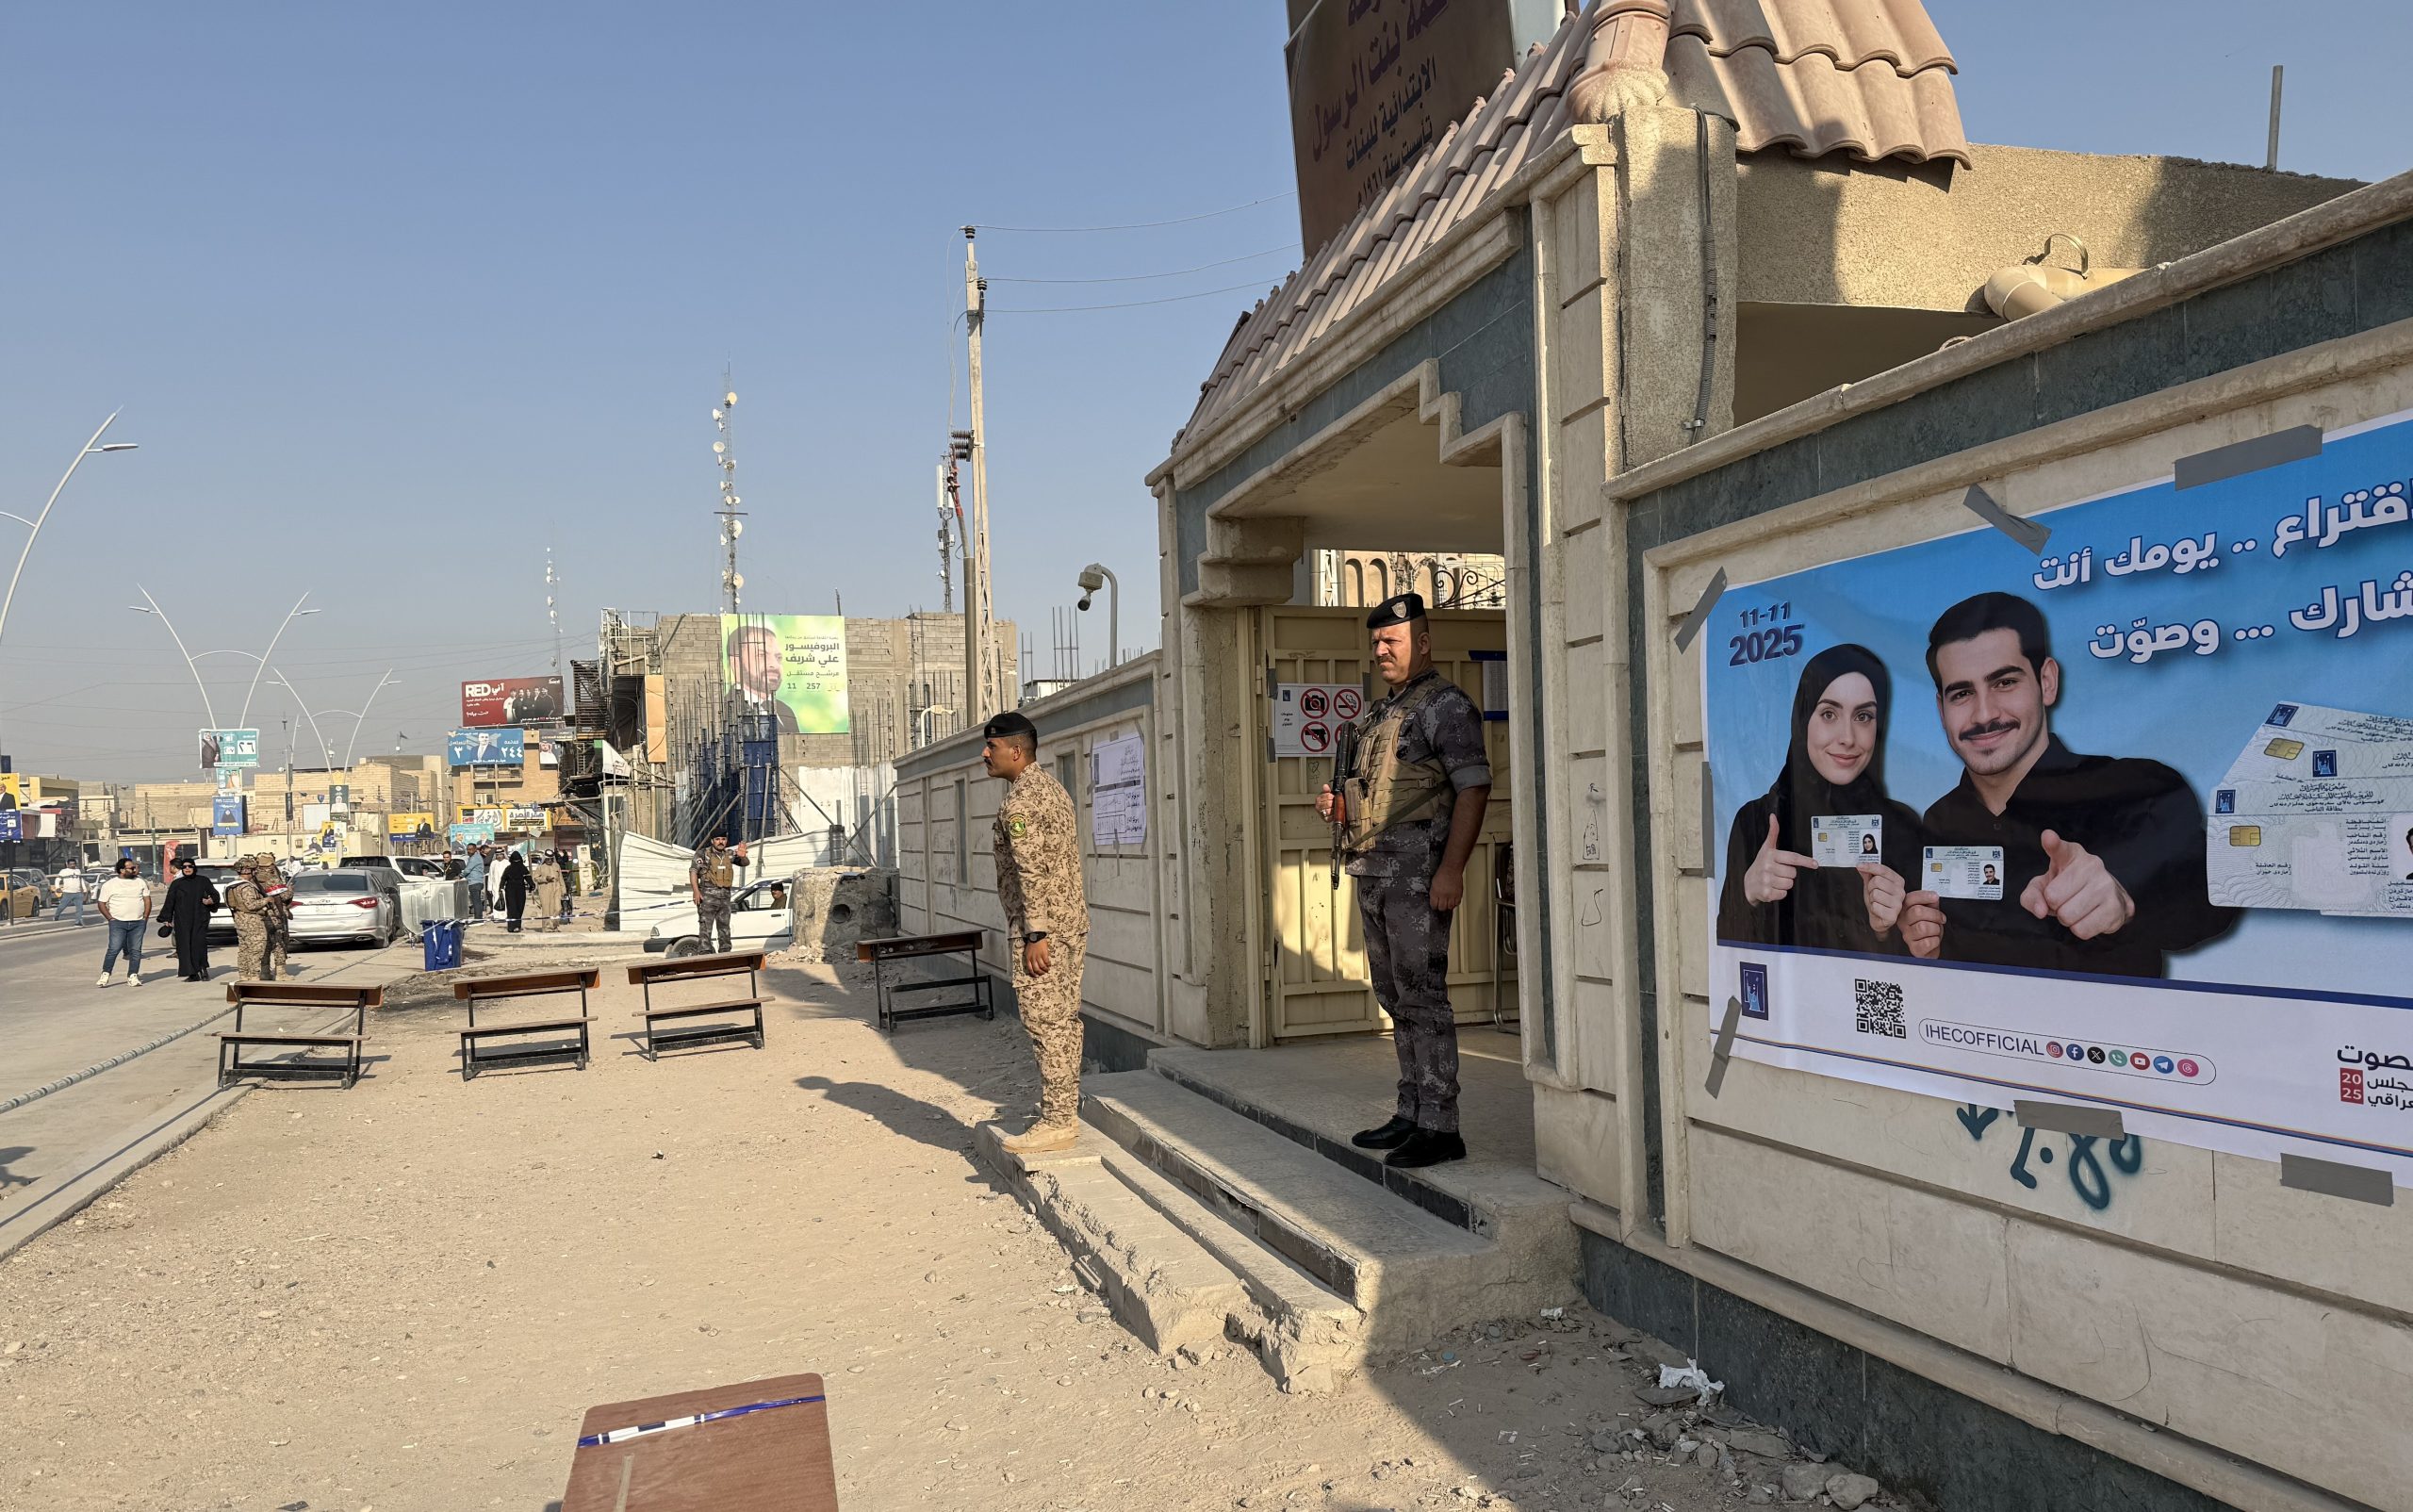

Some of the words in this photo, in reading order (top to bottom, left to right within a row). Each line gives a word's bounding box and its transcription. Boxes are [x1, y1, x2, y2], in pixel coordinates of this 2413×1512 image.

[1312, 52, 1365, 162] الرسول
[1346, 116, 1378, 169] للبنات
[2271, 477, 2413, 559] قتراع
[2105, 531, 2218, 576] يومك
[2032, 546, 2093, 591] أنت
[1739, 601, 1790, 630] 11-11
[785, 642, 840, 652] البروفيسور
[785, 652, 815, 665] شريف
[1729, 623, 1805, 667] 2025
[815, 669, 840, 678] مرشح
[818, 654, 840, 668] علي
[465, 683, 491, 698] RED
[1926, 1024, 2044, 1056] IHECOFFICIAL
[2338, 1044, 2413, 1072] صوت
[2341, 1073, 2362, 1085] 20
[2367, 1076, 2413, 1093] جلس
[2342, 1087, 2362, 1100] 25
